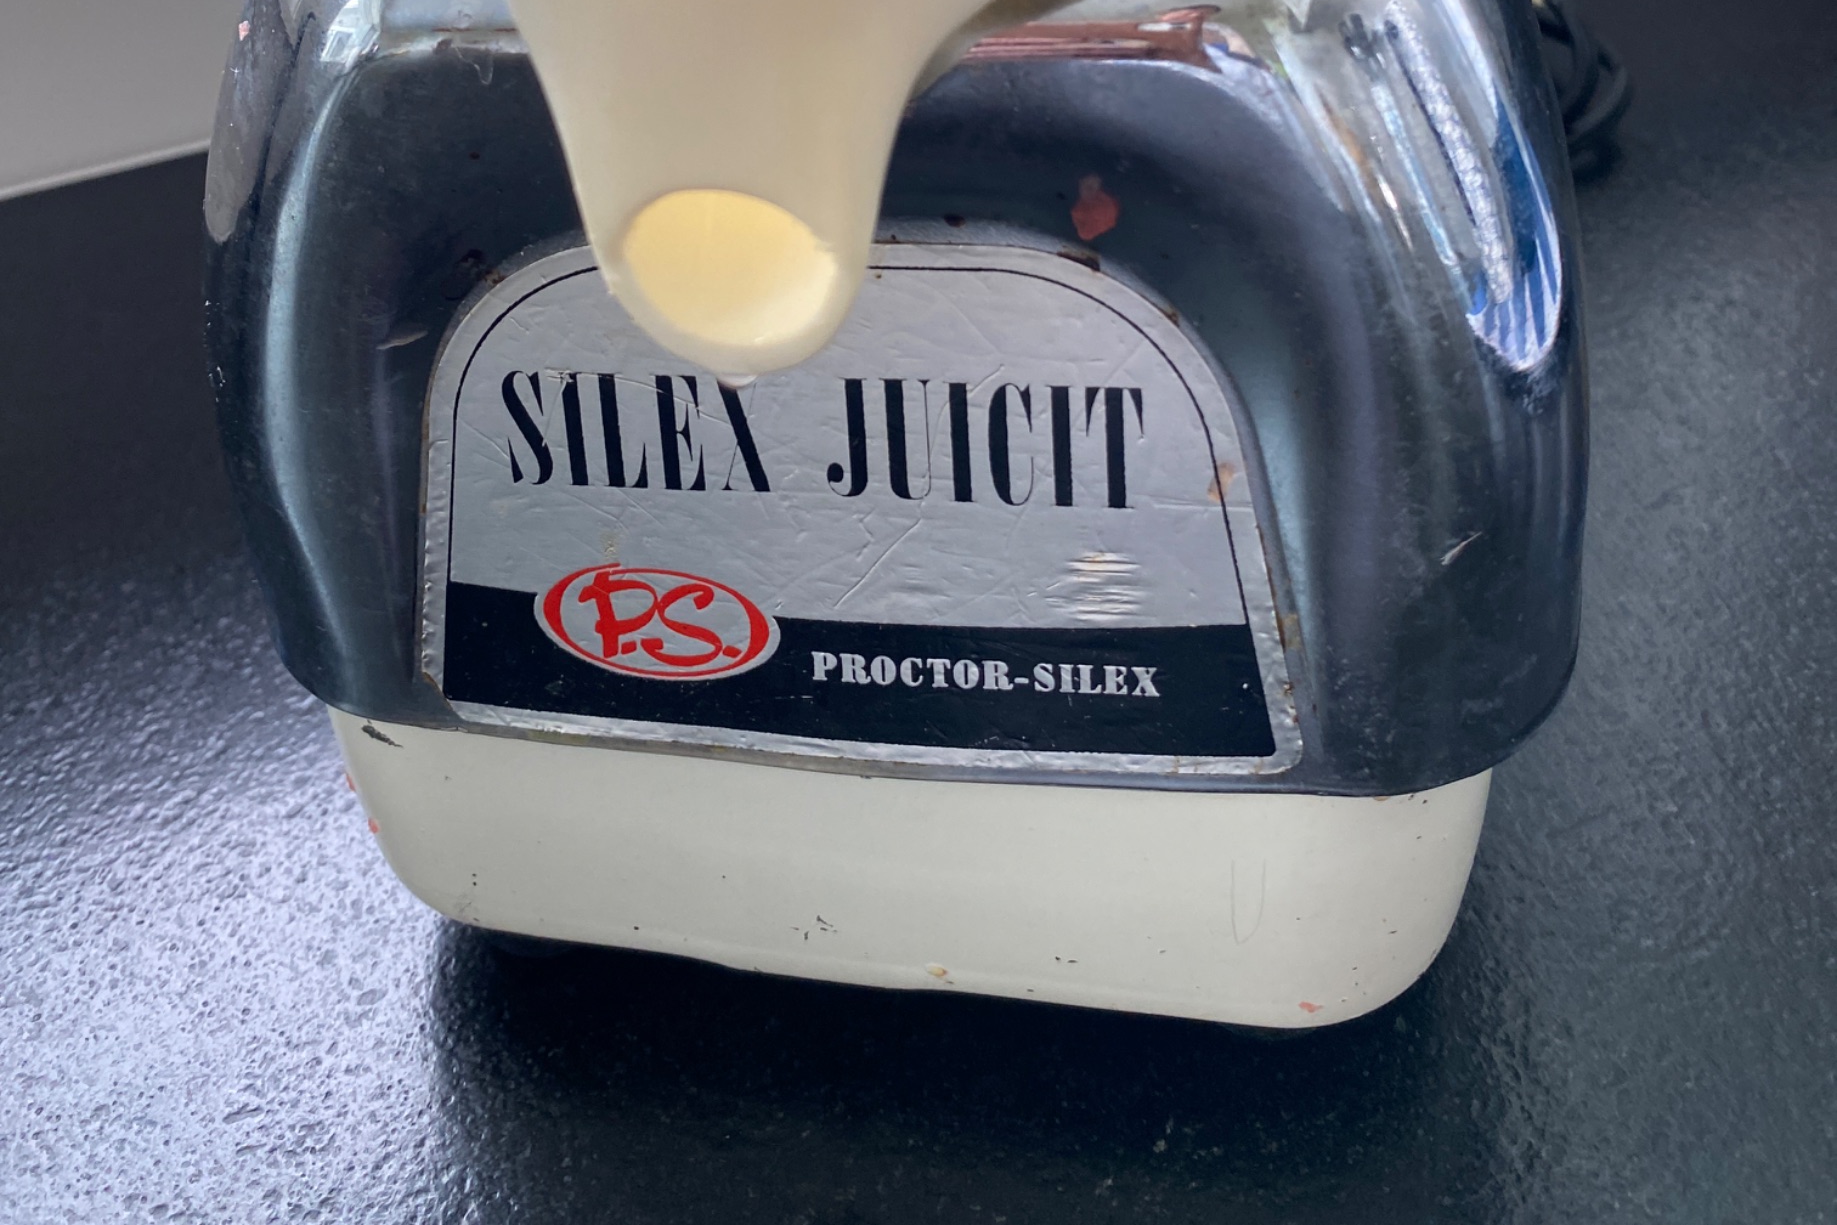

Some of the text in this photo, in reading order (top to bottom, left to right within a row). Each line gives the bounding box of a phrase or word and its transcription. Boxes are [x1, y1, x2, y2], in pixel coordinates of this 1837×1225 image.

[502, 369, 1145, 509] SILEX JUICIT
[811, 651, 1161, 698] PROCTOR-SILEX
